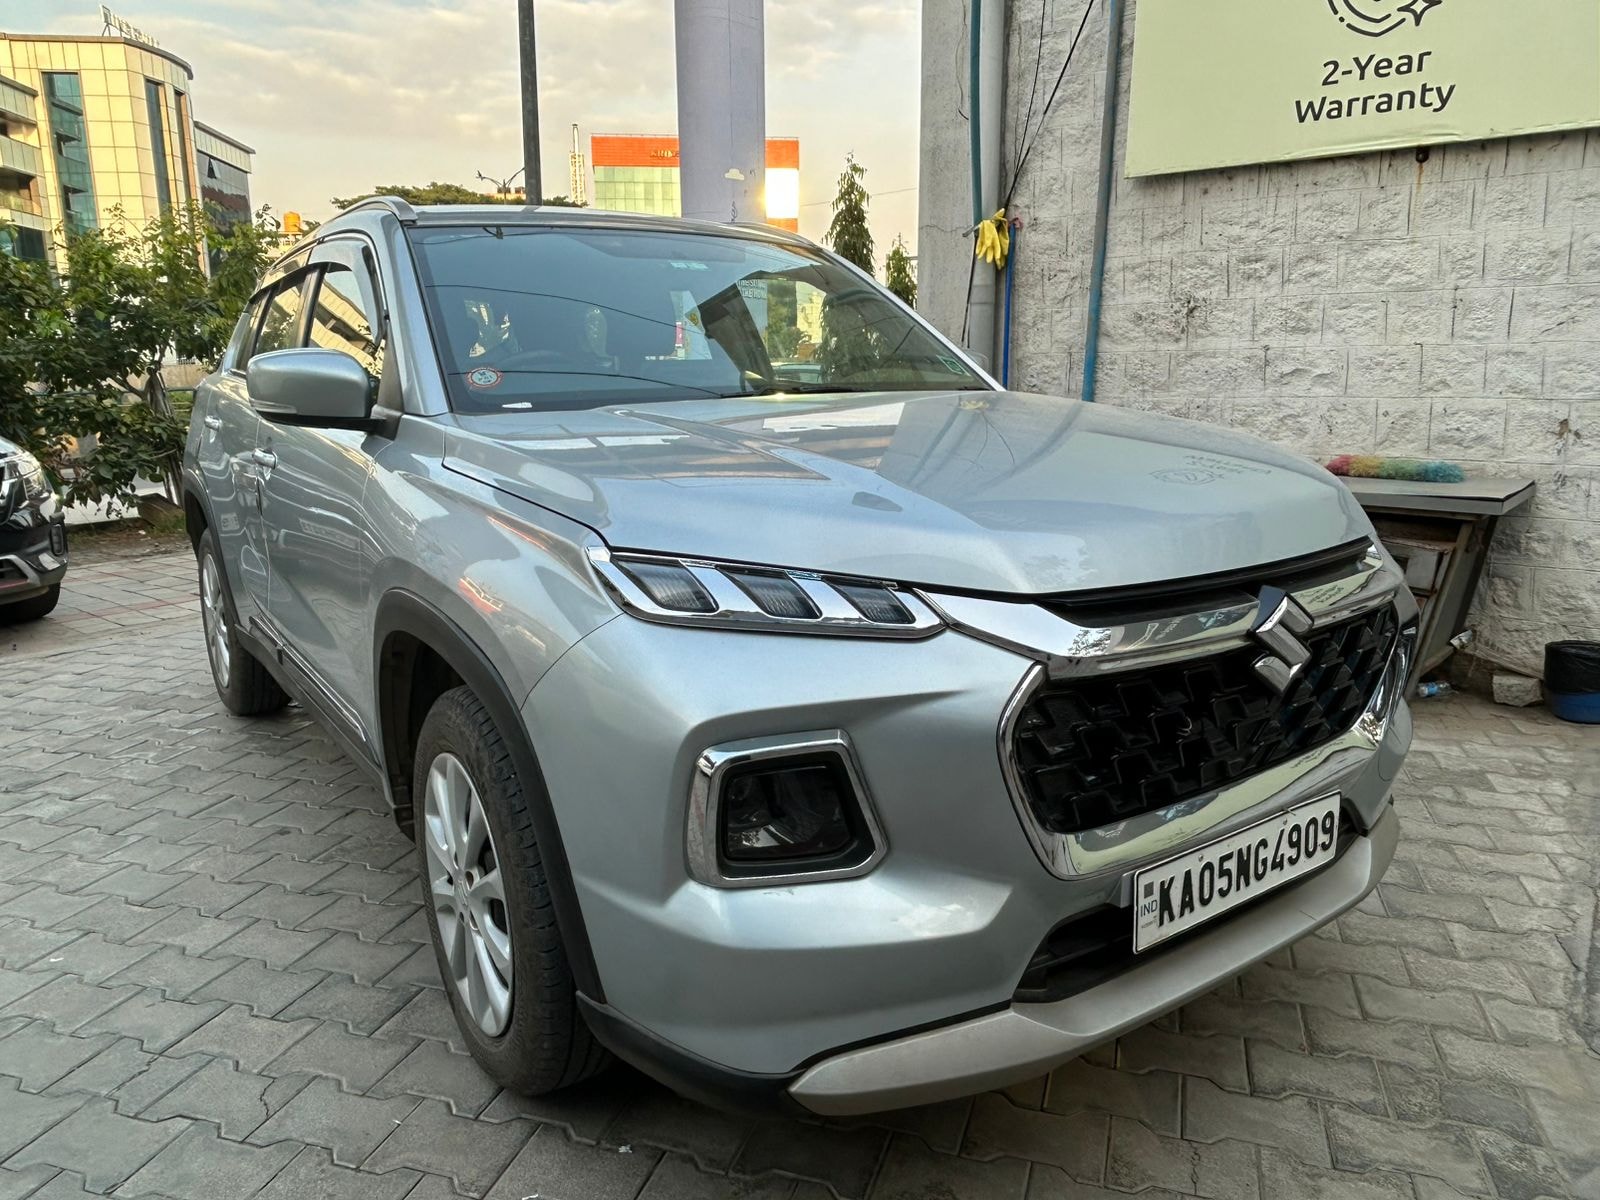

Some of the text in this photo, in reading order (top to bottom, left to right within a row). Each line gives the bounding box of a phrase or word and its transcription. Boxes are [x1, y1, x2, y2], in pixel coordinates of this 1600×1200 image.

[1321, 51, 1432, 86] 2-Year
[1295, 82, 1456, 124] Warranty
[1158, 810, 1335, 927] KA05NG4909
[1140, 899, 1158, 918] IND
